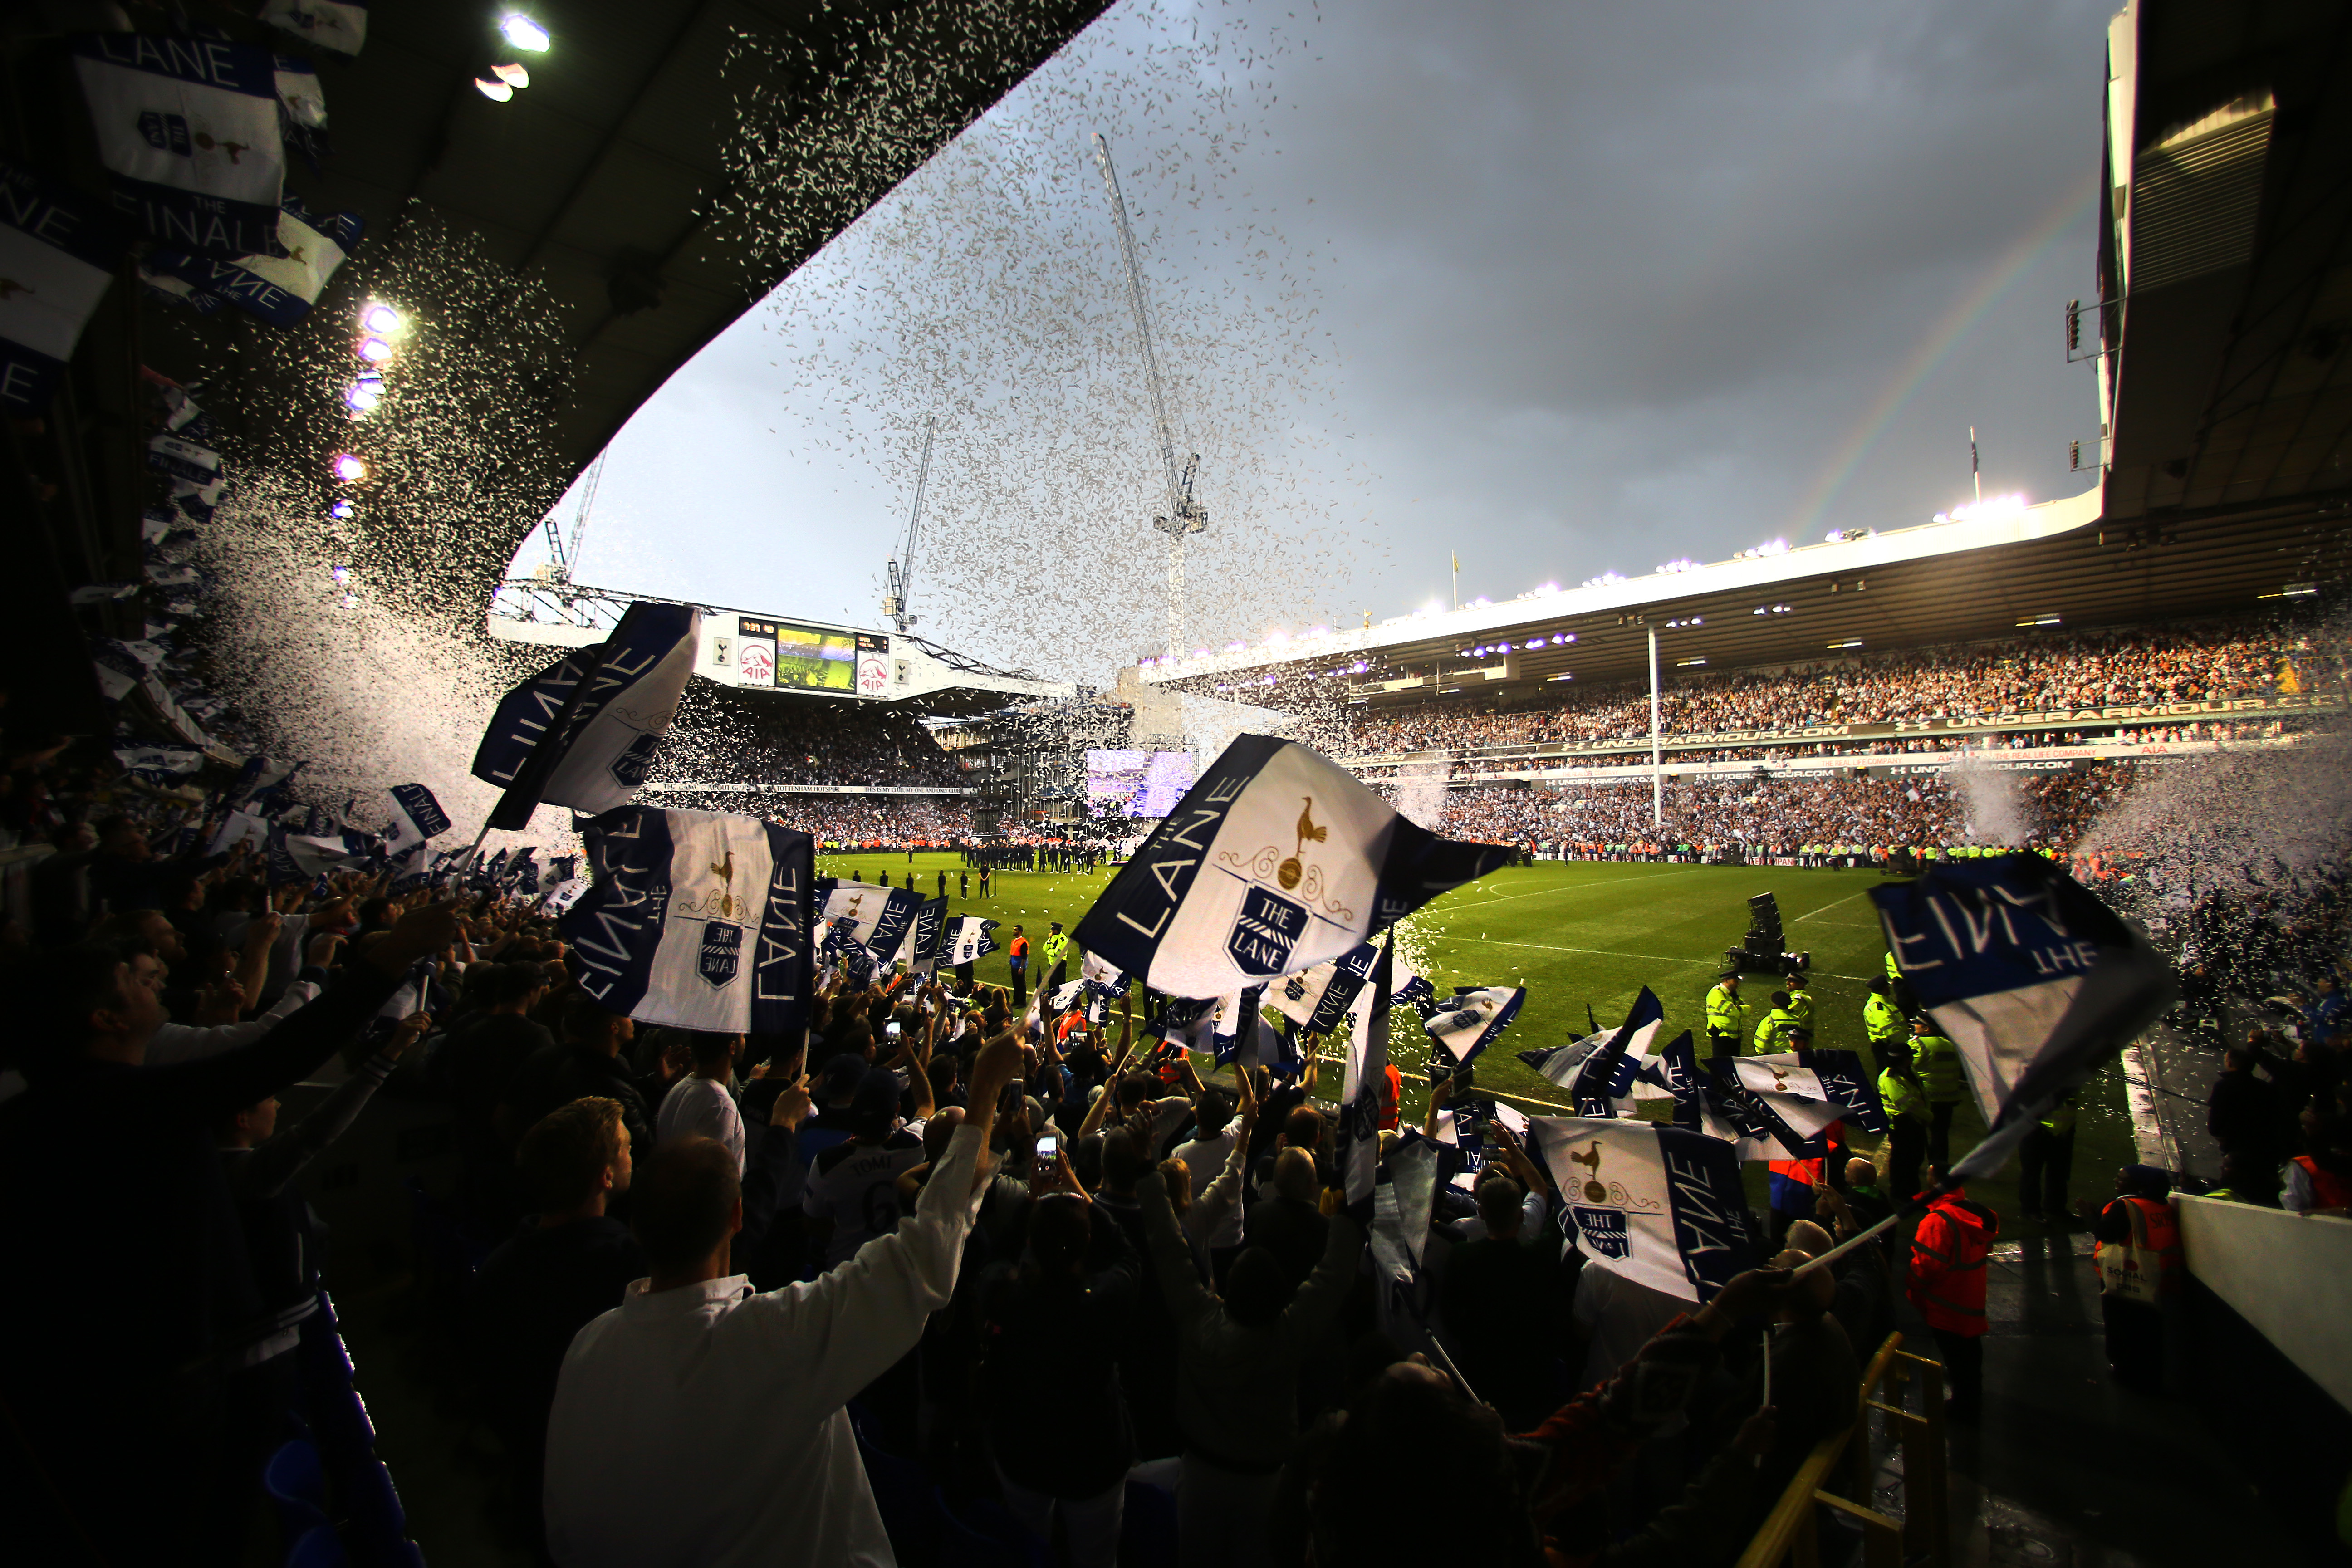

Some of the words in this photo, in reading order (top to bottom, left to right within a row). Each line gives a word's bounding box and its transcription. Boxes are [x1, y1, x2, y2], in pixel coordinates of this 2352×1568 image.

[98, 35, 240, 88] LANE
[192, 196, 226, 215] THE
[742, 667, 771, 680] AIA
[861, 679, 885, 691] AIA
[1591, 726, 1850, 750] UNDERARMOUR.COM
[1868, 757, 1903, 765] COMPANY
[2053, 749, 2097, 757] COMPANY
[616, 761, 650, 779] LAN
[1149, 816, 1184, 851] THE
[1116, 775, 1250, 940] LANE
[1261, 897, 1295, 930] THE
[1234, 933, 1283, 972] LANE
[1820, 1075, 1836, 1095] THE
